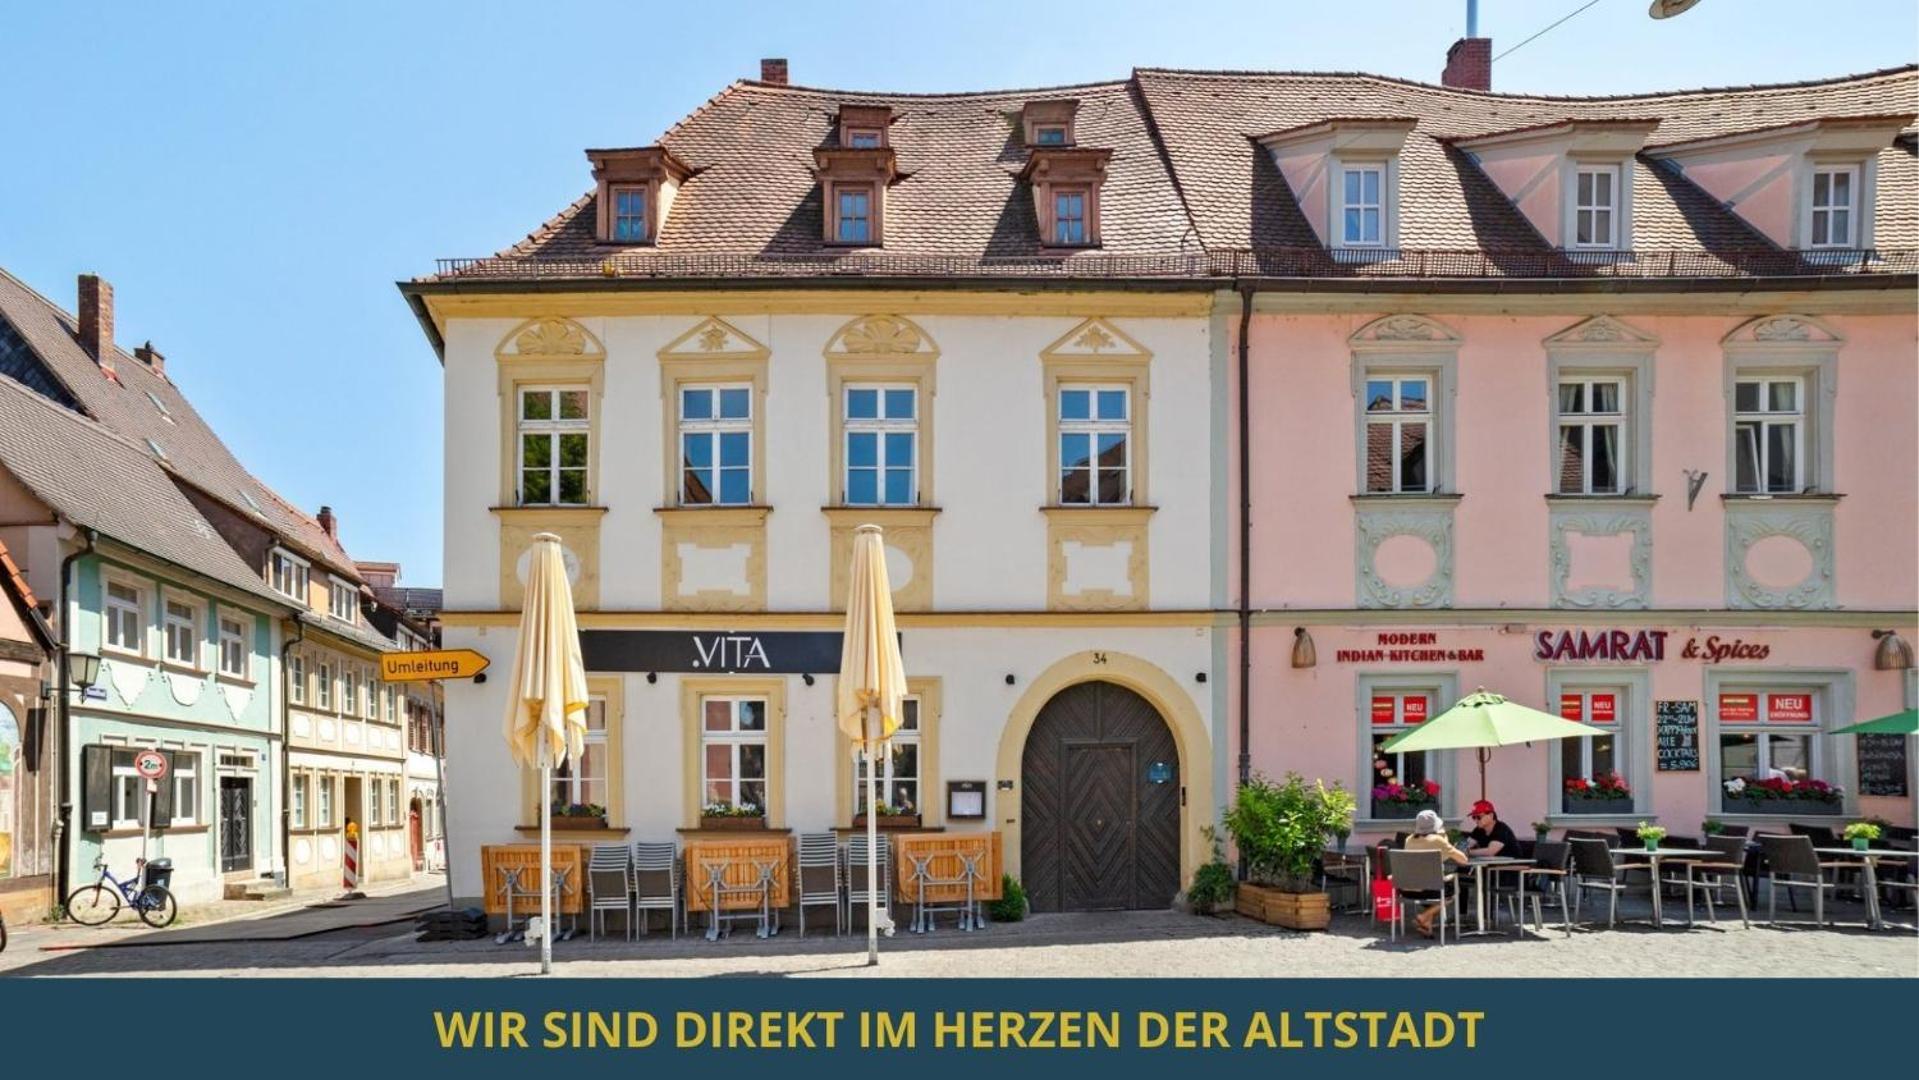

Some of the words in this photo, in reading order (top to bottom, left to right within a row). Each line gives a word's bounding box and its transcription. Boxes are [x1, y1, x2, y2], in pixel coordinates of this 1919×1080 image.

[1378, 633, 1436, 645] MODERN
[1536, 629, 1668, 662] SAMRAT
[1681, 638, 1700, 659] &
[1702, 635, 1770, 663] Spices
[1092, 652, 1107, 665] 34
[387, 660, 459, 674] Umleitung
[1406, 703, 1424, 711] NEU
[1593, 701, 1612, 710] NEU
[1775, 698, 1803, 710] NEU
